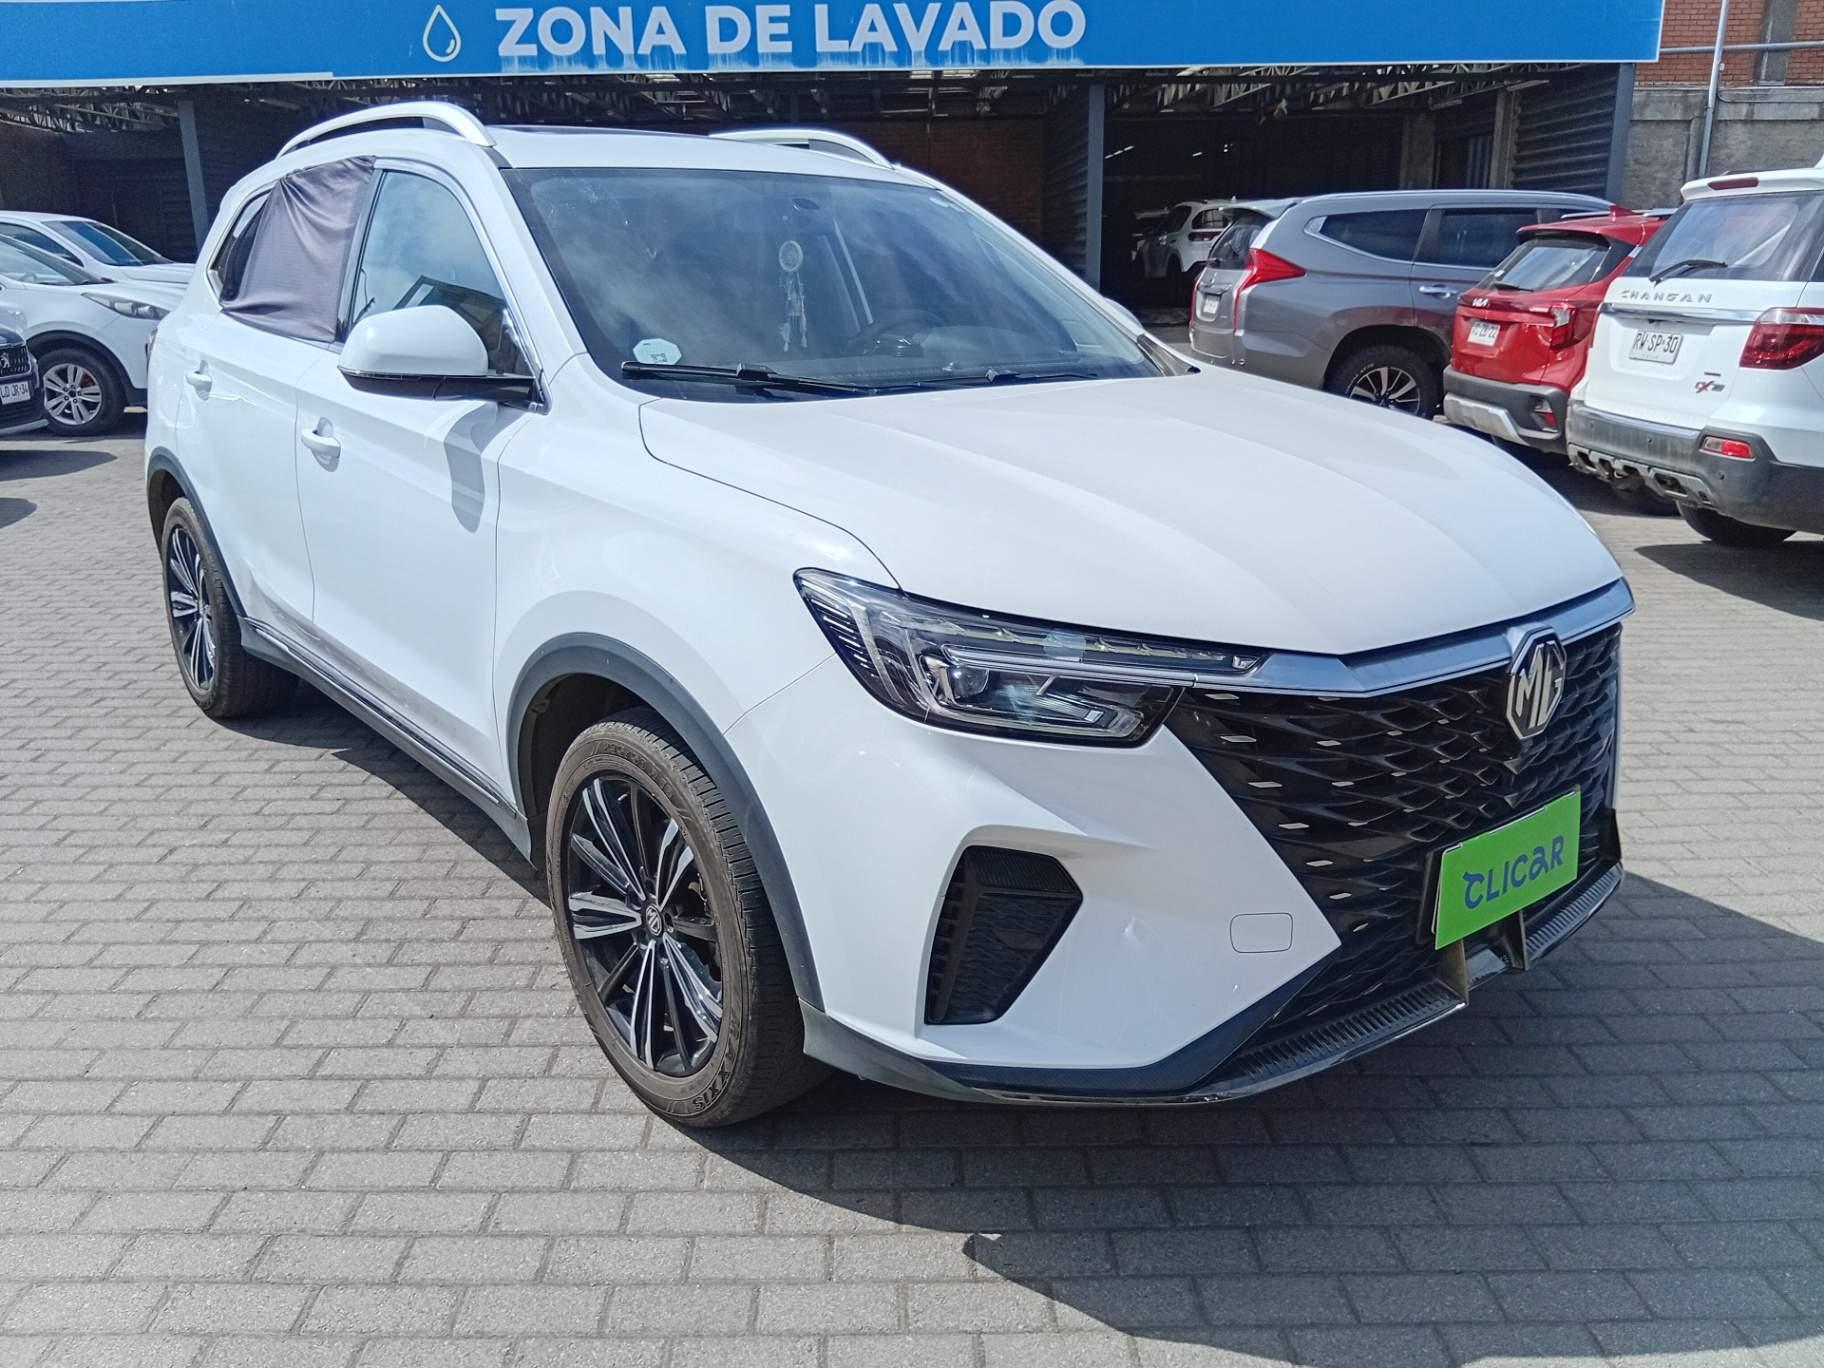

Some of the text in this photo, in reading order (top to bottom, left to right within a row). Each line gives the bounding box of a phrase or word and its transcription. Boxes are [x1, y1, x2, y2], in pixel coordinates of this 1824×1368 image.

[495, 0, 1087, 56] ZONA DE LAVADO
[1622, 290, 1712, 303] CHANGAN
[1515, 640, 1563, 730] MG
